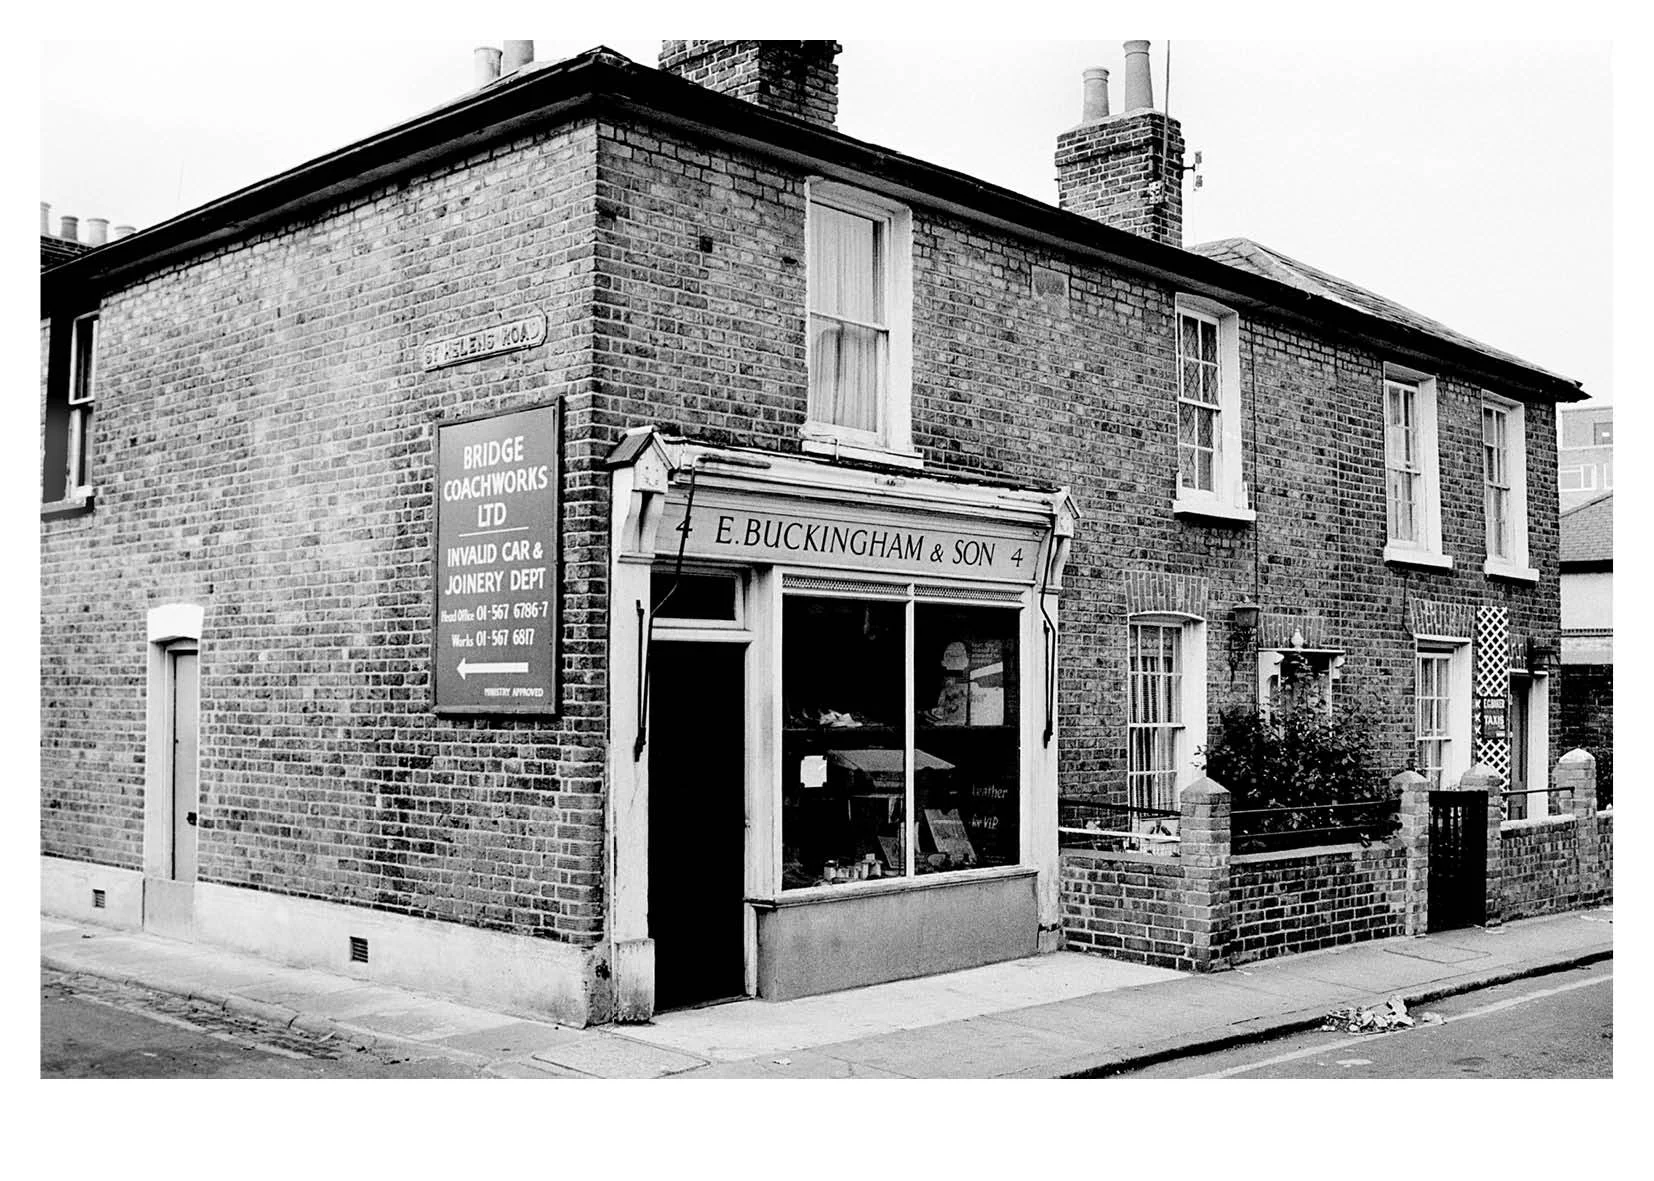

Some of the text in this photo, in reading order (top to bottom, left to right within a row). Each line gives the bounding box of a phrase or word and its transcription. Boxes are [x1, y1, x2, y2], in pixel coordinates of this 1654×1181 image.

[463, 436, 524, 470] BRIDGE
[443, 465, 548, 502] COACHWORKS
[478, 502, 507, 527] LTD
[447, 540, 544, 567] INVALID CAR &
[676, 515, 693, 539] 4
[930, 543, 944, 563] &
[952, 539, 996, 566] SON
[1010, 548, 1024, 567] 4
[444, 567, 546, 595] JOINERY DEPT
[441, 610, 457, 622] Head
[457, 608, 475, 621] Office
[451, 633, 474, 648] Works
[512, 628, 535, 646] 6817
[484, 688, 544, 697] MINISTRY APPROVED
[1483, 714, 1505, 726] TAXIS
